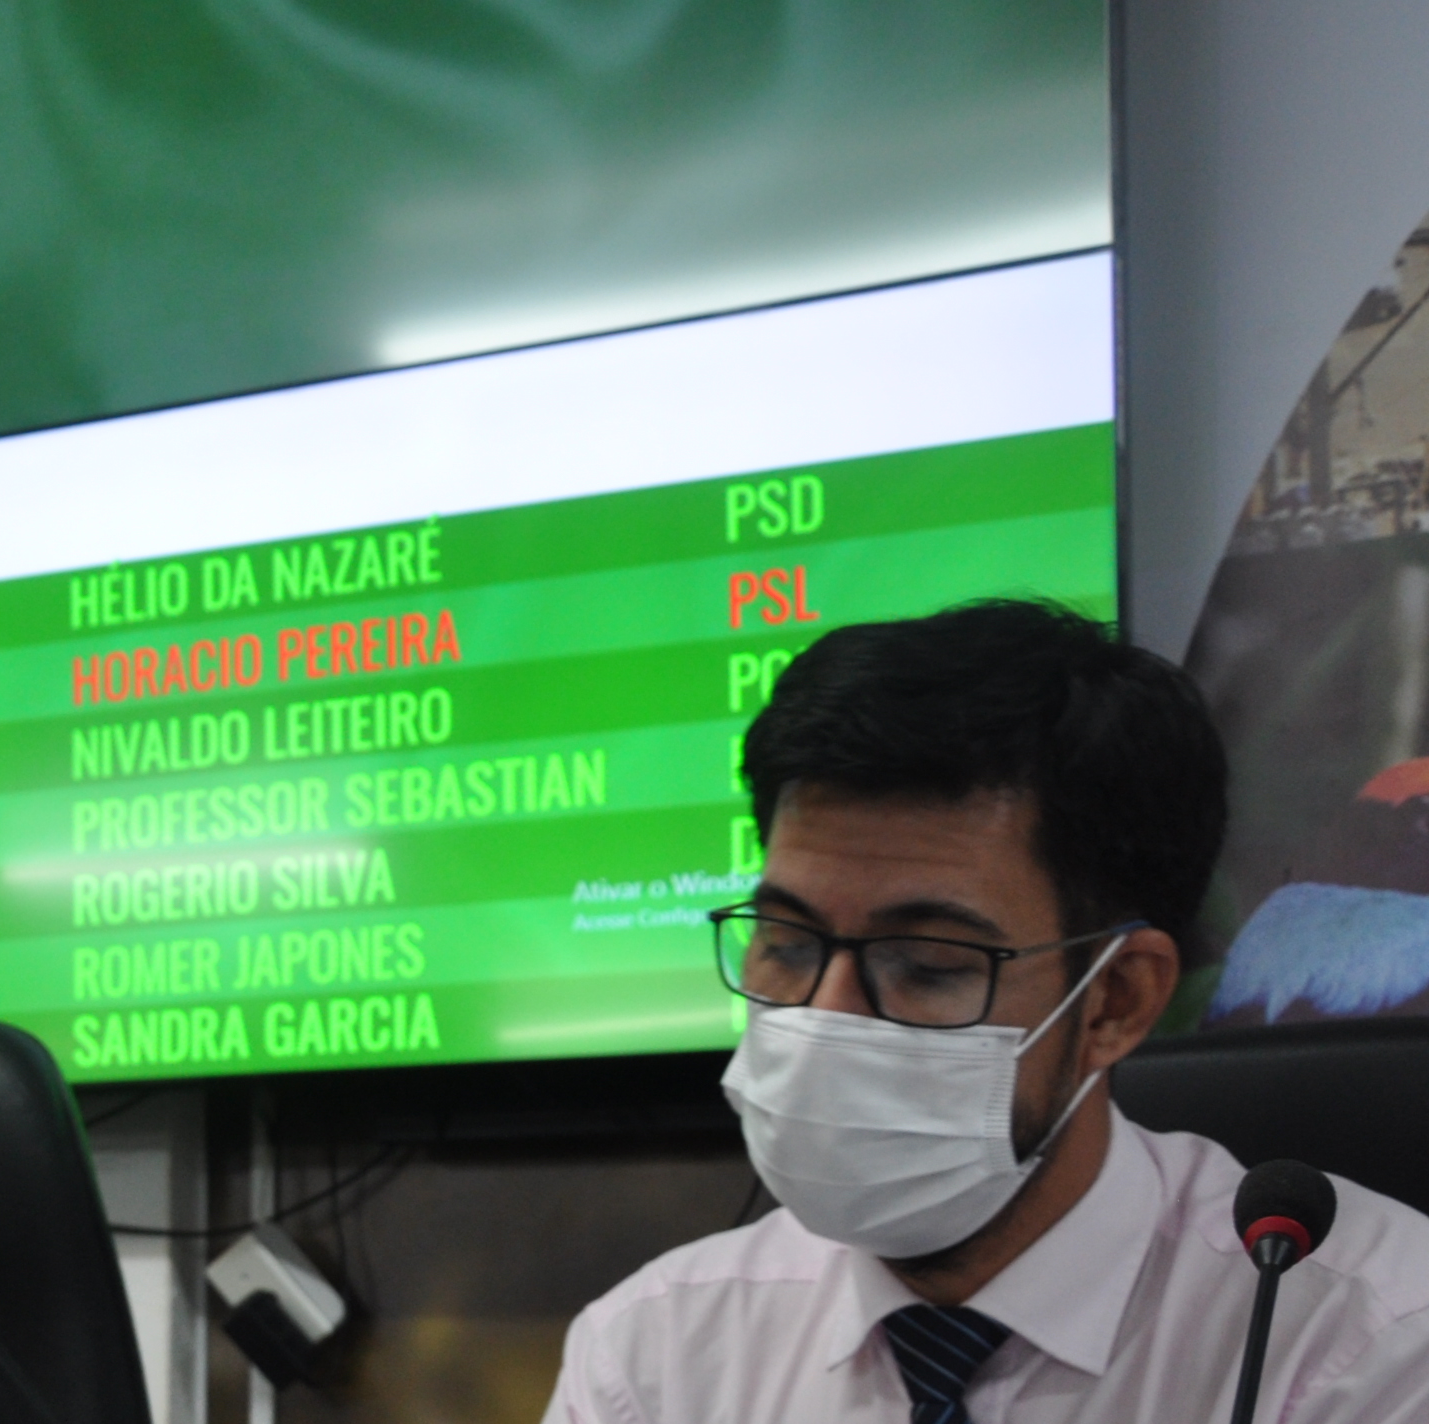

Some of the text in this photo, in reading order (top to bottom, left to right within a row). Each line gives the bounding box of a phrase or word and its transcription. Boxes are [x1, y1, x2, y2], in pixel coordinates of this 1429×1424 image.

[70, 474, 825, 629] HÉLIO DA NAZARÉ PSD
[71, 564, 821, 707] HORACIO PEREIRA PSL
[71, 688, 453, 782] NIVALDO LEITEIRO
[72, 749, 607, 855] PROFESSOR SEBASTIAN
[72, 848, 396, 928] ROGERIO SILVA
[73, 922, 426, 1001] ROMER JAPONES
[72, 994, 439, 1069] SANDRA GARCIA
